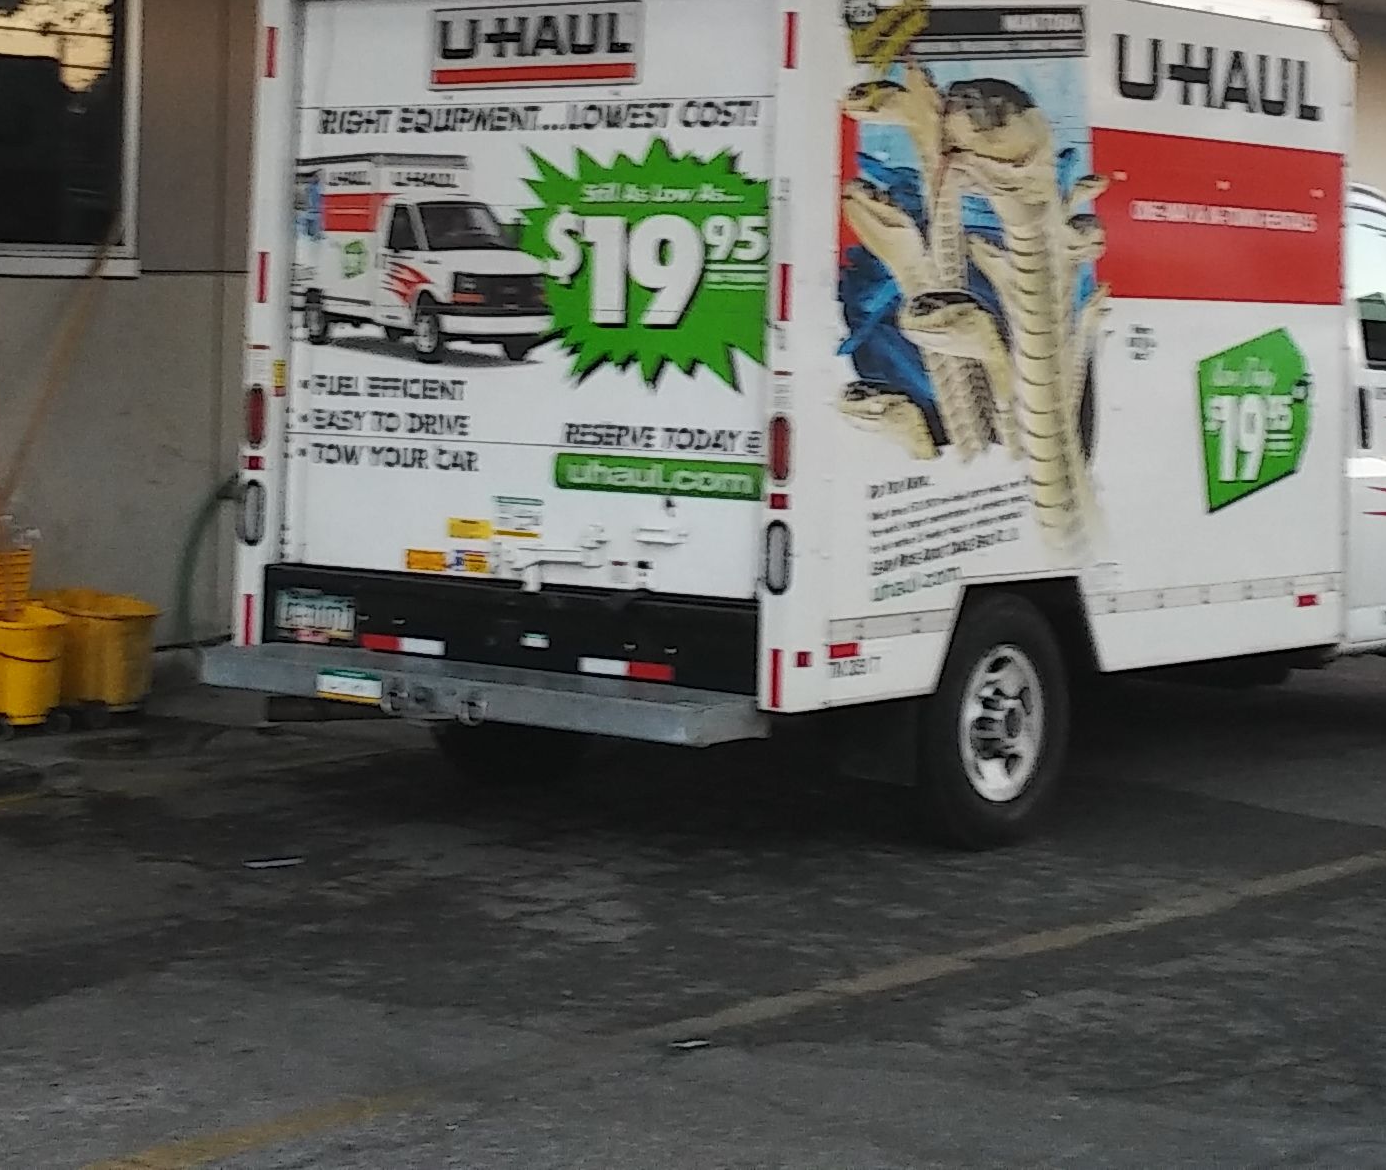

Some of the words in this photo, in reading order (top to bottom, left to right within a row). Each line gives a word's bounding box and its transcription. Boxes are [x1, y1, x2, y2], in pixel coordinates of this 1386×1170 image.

[438, 12, 633, 59] U-HAUL
[1114, 33, 1324, 121] U-HAUL
[318, 109, 392, 133] RIGHT
[312, 374, 360, 397] FUEL
[312, 408, 363, 431] EASY
[370, 410, 401, 432] TO
[404, 412, 470, 436] DRIVE
[564, 423, 654, 448] RESERVE
[662, 427, 741, 452] TODAY
[312, 442, 360, 465] TOW
[368, 445, 429, 469] YOUR
[436, 447, 479, 471] CAR
[566, 458, 756, 495] uhaul.com
